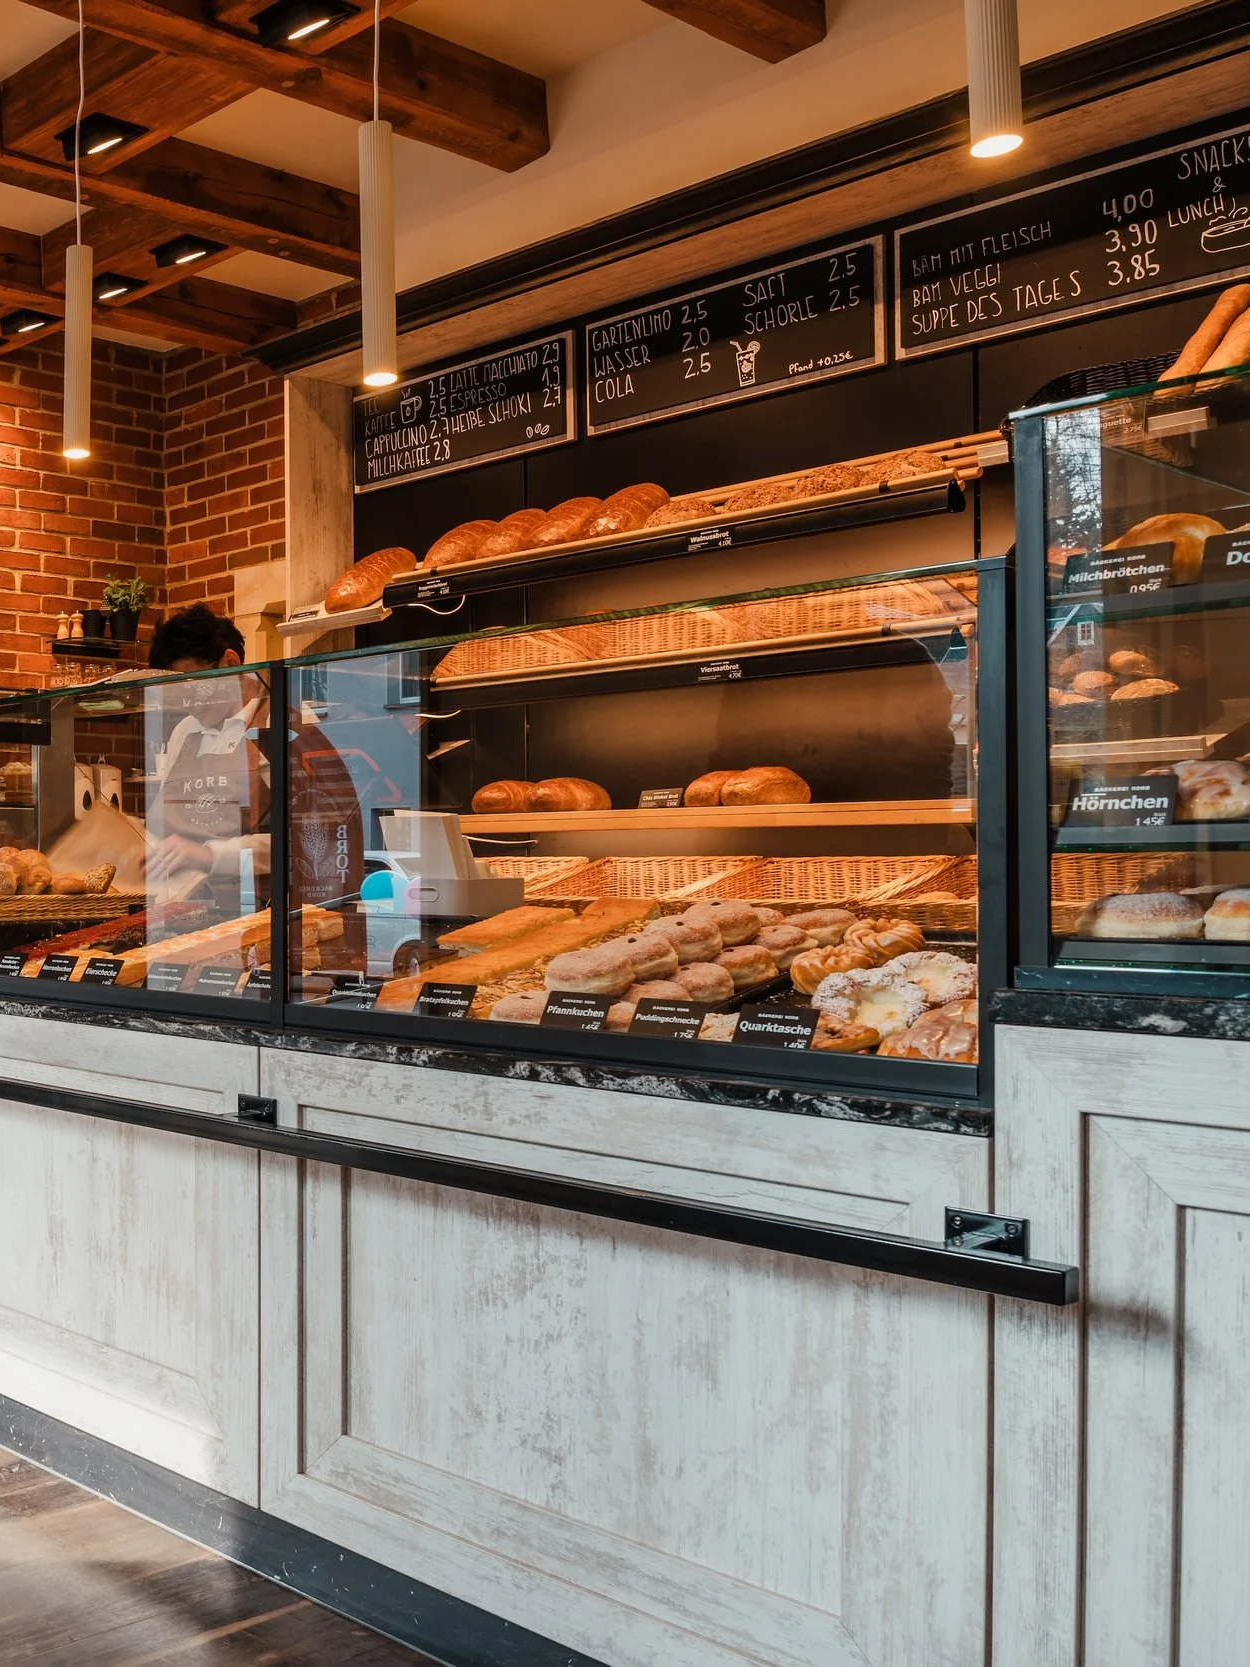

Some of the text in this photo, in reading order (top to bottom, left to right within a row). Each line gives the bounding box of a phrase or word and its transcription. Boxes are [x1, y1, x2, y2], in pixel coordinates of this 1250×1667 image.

[1177, 135, 1250, 180] SNACK
[1212, 176, 1226, 193] &
[1167, 193, 1225, 228] LUNCH
[912, 253, 942, 277] BÄM
[950, 243, 974, 265] MIT
[981, 221, 1052, 256] FLEISCH
[742, 273, 785, 307] SAFT
[912, 281, 942, 308] BÄM
[950, 263, 1001, 296] VEGGI
[744, 295, 819, 335] SCHORLE
[912, 303, 960, 335] SUPPE
[967, 292, 1003, 323] DES
[592, 309, 671, 352] GARTENLIMO
[450, 366, 480, 393] LATTE
[483, 350, 538, 383] MACCHIATO
[594, 344, 651, 378] WASSER
[789, 359, 813, 375] Pfand
[450, 382, 507, 413] ESPRESSO
[595, 373, 634, 403] COLA
[362, 397, 380, 417] TEE
[488, 392, 531, 424] SCHOKI
[364, 411, 396, 437] KAFFEE
[365, 424, 428, 459] CAPPUCCINO
[367, 445, 430, 479] MILCHKAFFEE
[690, 531, 730, 543] Walnussbrot
[1068, 564, 1165, 584] Milchbrötchen
[228, 741, 237, 749] K
[183, 775, 228, 794] KORB
[1072, 794, 1169, 811] Hörnchen
[85, 967, 118, 977] Eierschecke
[419, 995, 469, 1006] Bratapfelkuchen
[546, 1005, 605, 1018] Pfannkuchen
[635, 1013, 700, 1026] Puddingschnecke
[739, 1020, 812, 1036] Quarktasche
